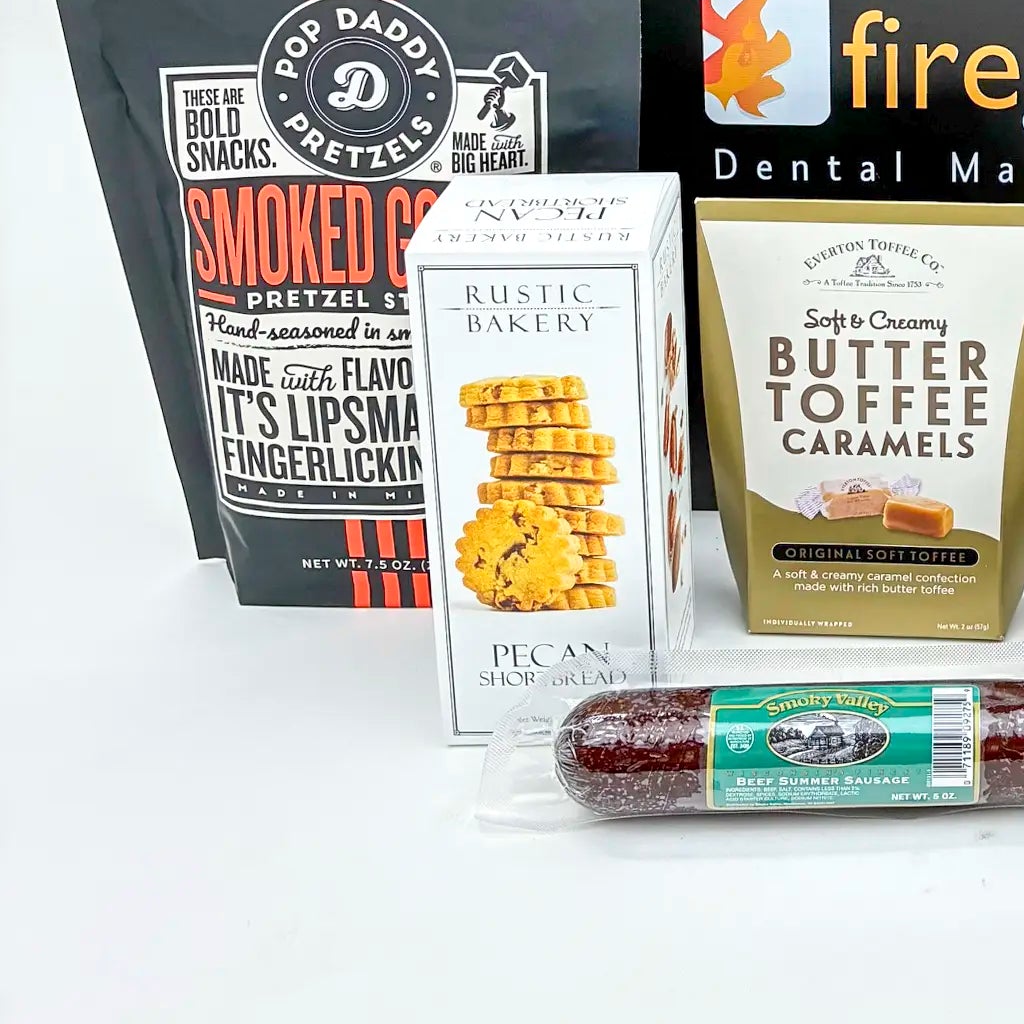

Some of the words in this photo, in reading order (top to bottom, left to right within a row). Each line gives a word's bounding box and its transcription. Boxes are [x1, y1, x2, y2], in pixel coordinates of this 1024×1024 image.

[274, 19, 321, 80] POP
[335, 7, 441, 79] DADDY
[182, 88, 220, 107] THESE
[222, 87, 245, 105] ARE
[185, 107, 241, 140] BOLD
[283, 111, 433, 169] PRETZELS
[452, 131, 487, 151] MADE
[491, 134, 524, 151] with
[186, 138, 277, 173] SNACKS.
[451, 151, 476, 174] BIG
[480, 149, 529, 173] HEART.
[714, 148, 902, 183] Dental
[465, 196, 629, 208] SHORTBREAD
[474, 206, 607, 222] PECAN
[186, 181, 375, 287] SMOKED
[432, 232, 527, 244] BAKERY
[803, 240, 864, 270] EVERTON
[868, 238, 919, 260] TOFFEE
[246, 289, 370, 310] PRETZEL
[465, 283, 593, 305] RUSTIC
[205, 311, 360, 341] Hand-seasoned
[364, 322, 381, 341] in
[467, 312, 595, 333] BAKERY
[803, 308, 847, 336] Soft
[850, 313, 866, 329] &
[869, 309, 948, 337] Creamy
[211, 347, 274, 388] MADE
[280, 363, 337, 392] with
[342, 356, 414, 392] FLAVO
[769, 336, 989, 381] BUTTER
[765, 381, 988, 426] TOFFEE
[287, 392, 420, 445] LIPSMA
[782, 428, 975, 459] CARAMELS
[237, 483, 305, 499] MADE
[332, 490, 357, 500] IN
[302, 558, 331, 569] NET
[335, 559, 362, 569] WT.
[365, 559, 387, 570] 7.5
[391, 560, 416, 571] OZ.
[785, 547, 862, 560] ORIGINAL
[866, 549, 905, 561] SOFT
[911, 551, 967, 563] TOFFEE
[773, 569, 782, 578] A
[785, 570, 807, 579] soft
[810, 570, 819, 579] &
[821, 571, 863, 583] creamy
[867, 572, 912, 582] caramel
[913, 573, 977, 584] confection
[794, 582, 827, 592] made
[829, 582, 854, 592] with
[857, 582, 879, 593] rich
[882, 583, 917, 594] butter
[921, 584, 955, 595] toffee
[479, 670, 627, 687] SHORBREAD
[766, 694, 832, 717] Smoky
[835, 693, 890, 717] Valley
[736, 776, 774, 787] BEEF
[779, 775, 840, 786] SUMMER
[844, 775, 910, 785] SAUSAGE
[891, 793, 911, 801] NET
[912, 793, 931, 801] WT.
[941, 792, 958, 800] OZ.
